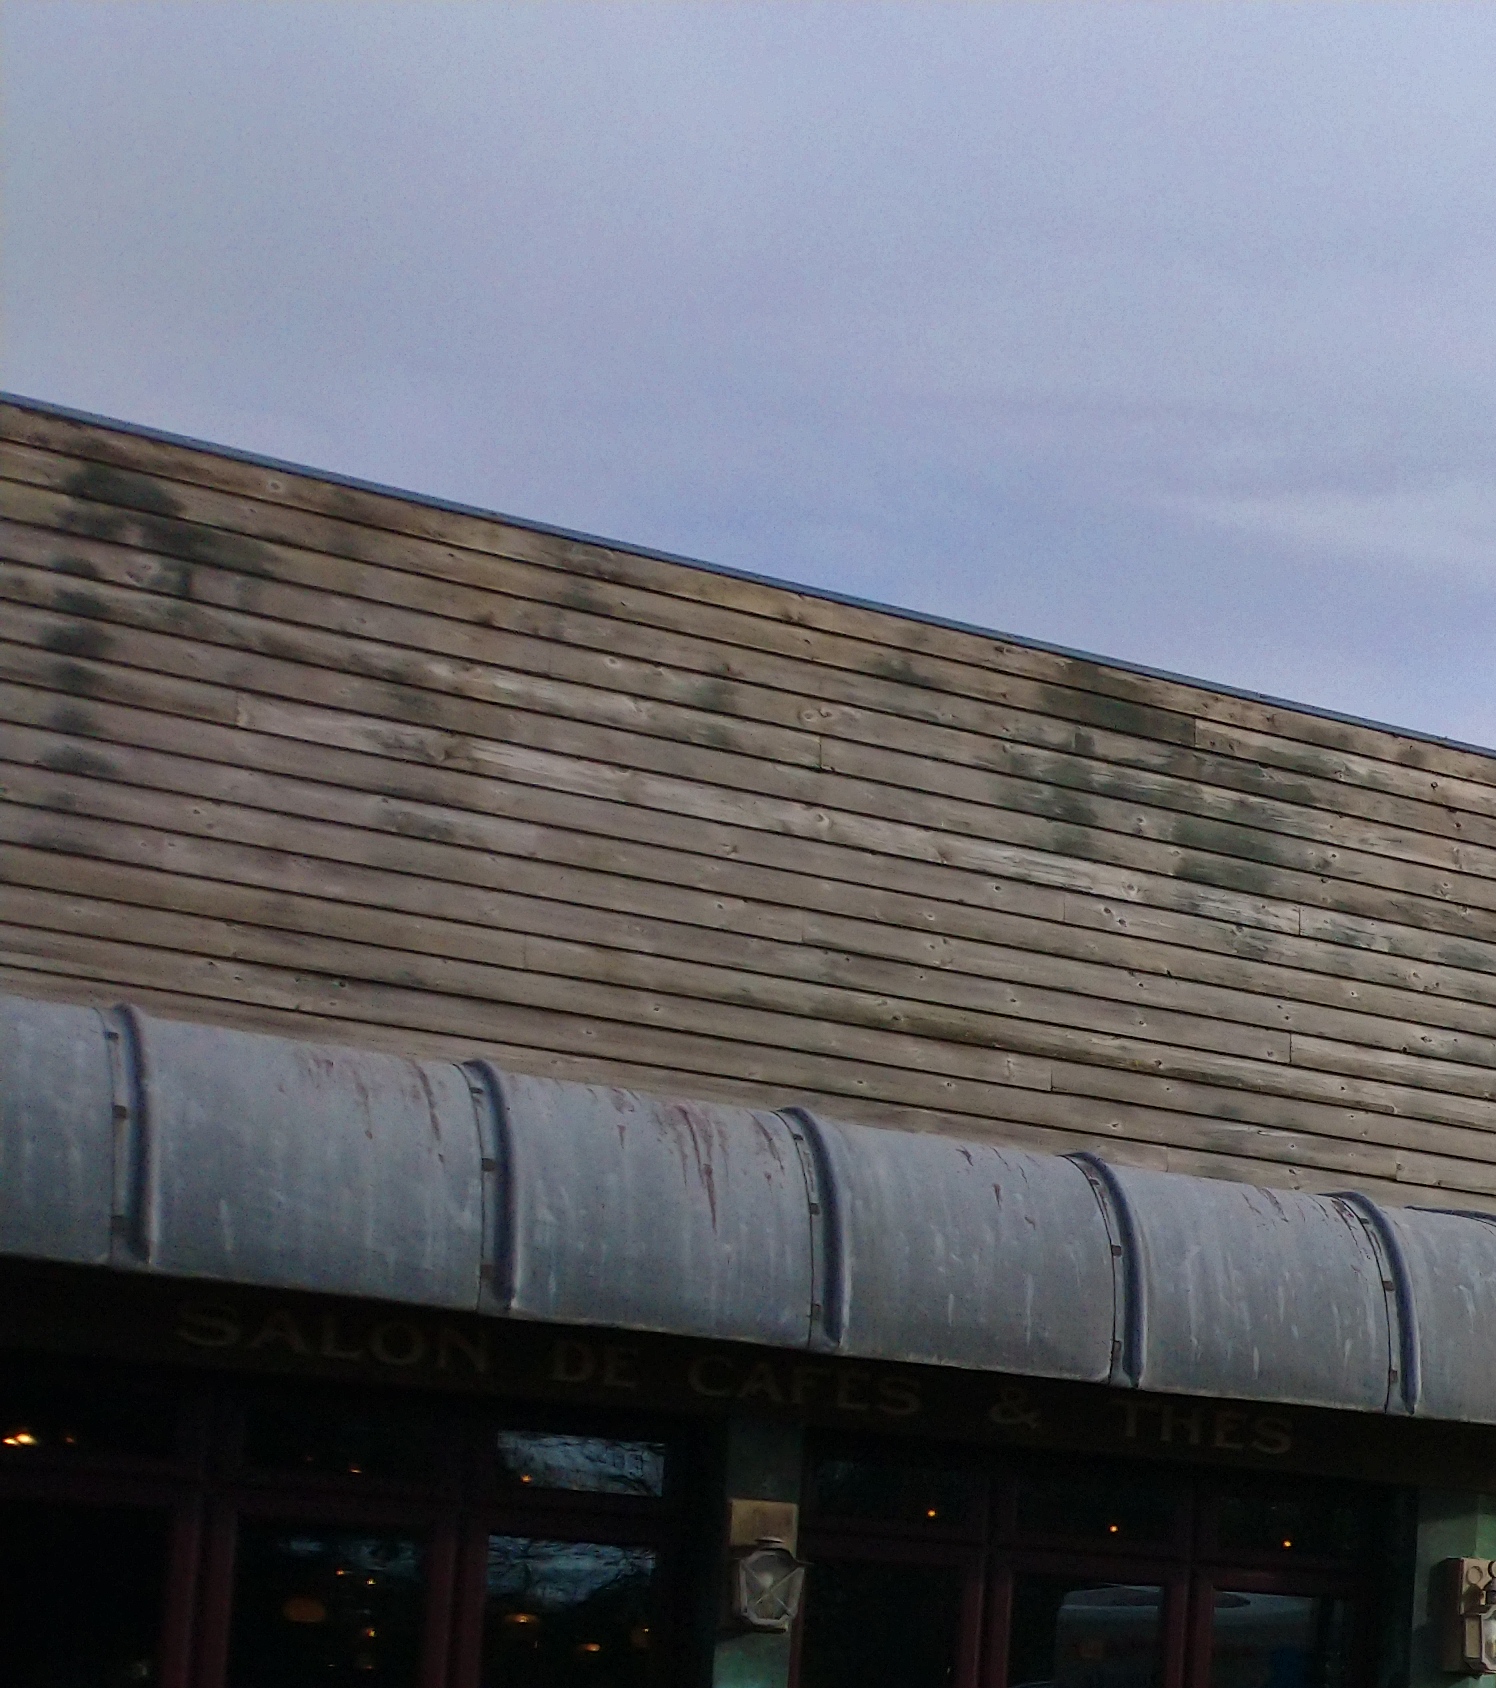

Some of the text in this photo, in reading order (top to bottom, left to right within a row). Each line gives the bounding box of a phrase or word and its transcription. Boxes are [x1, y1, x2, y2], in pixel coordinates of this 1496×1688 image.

[174, 1302, 488, 1373] SALON
[550, 1340, 640, 1389] DE
[988, 1386, 1038, 1429] &
